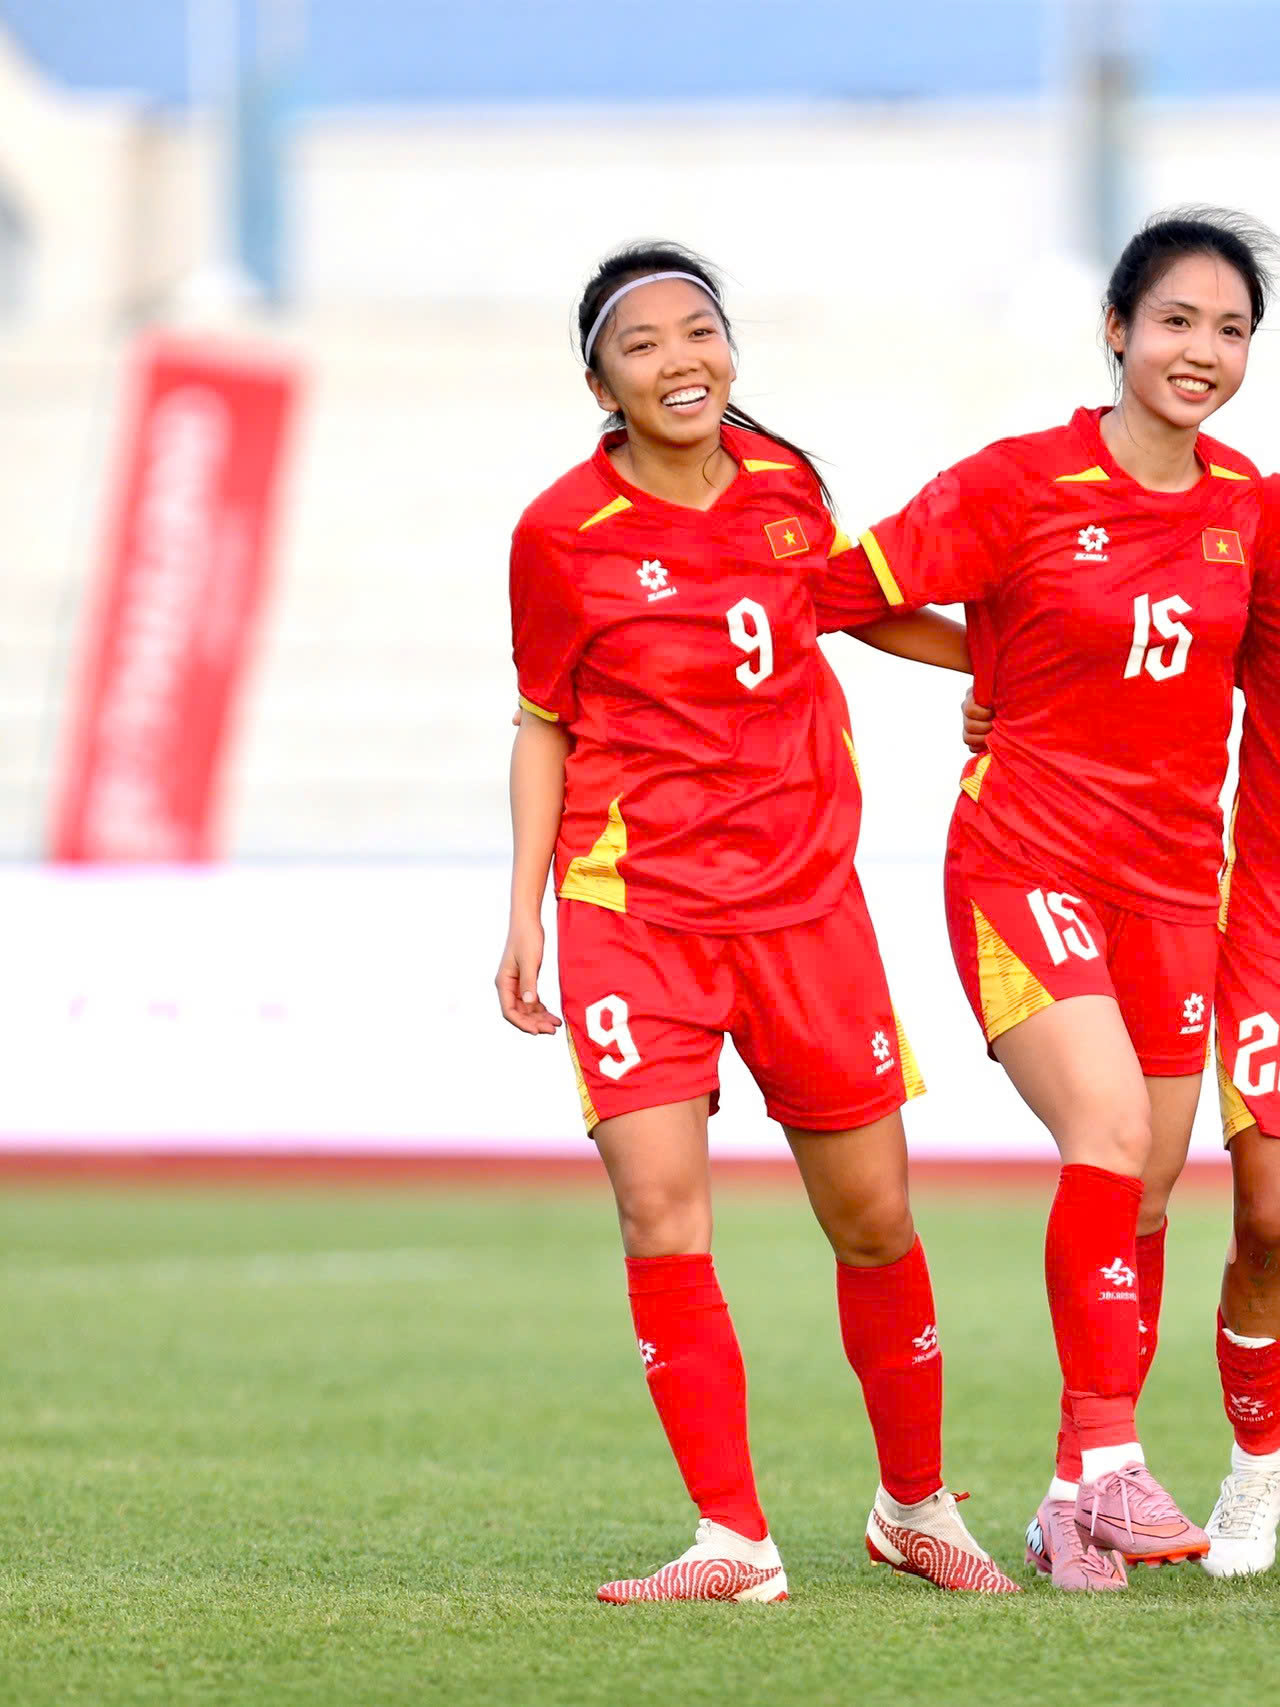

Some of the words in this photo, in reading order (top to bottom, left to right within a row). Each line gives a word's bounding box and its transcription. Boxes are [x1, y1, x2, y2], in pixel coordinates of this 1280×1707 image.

[725, 597, 774, 690] 9
[1123, 593, 1193, 682] 15
[1026, 888, 1100, 967] 15
[585, 993, 642, 1081] 9
